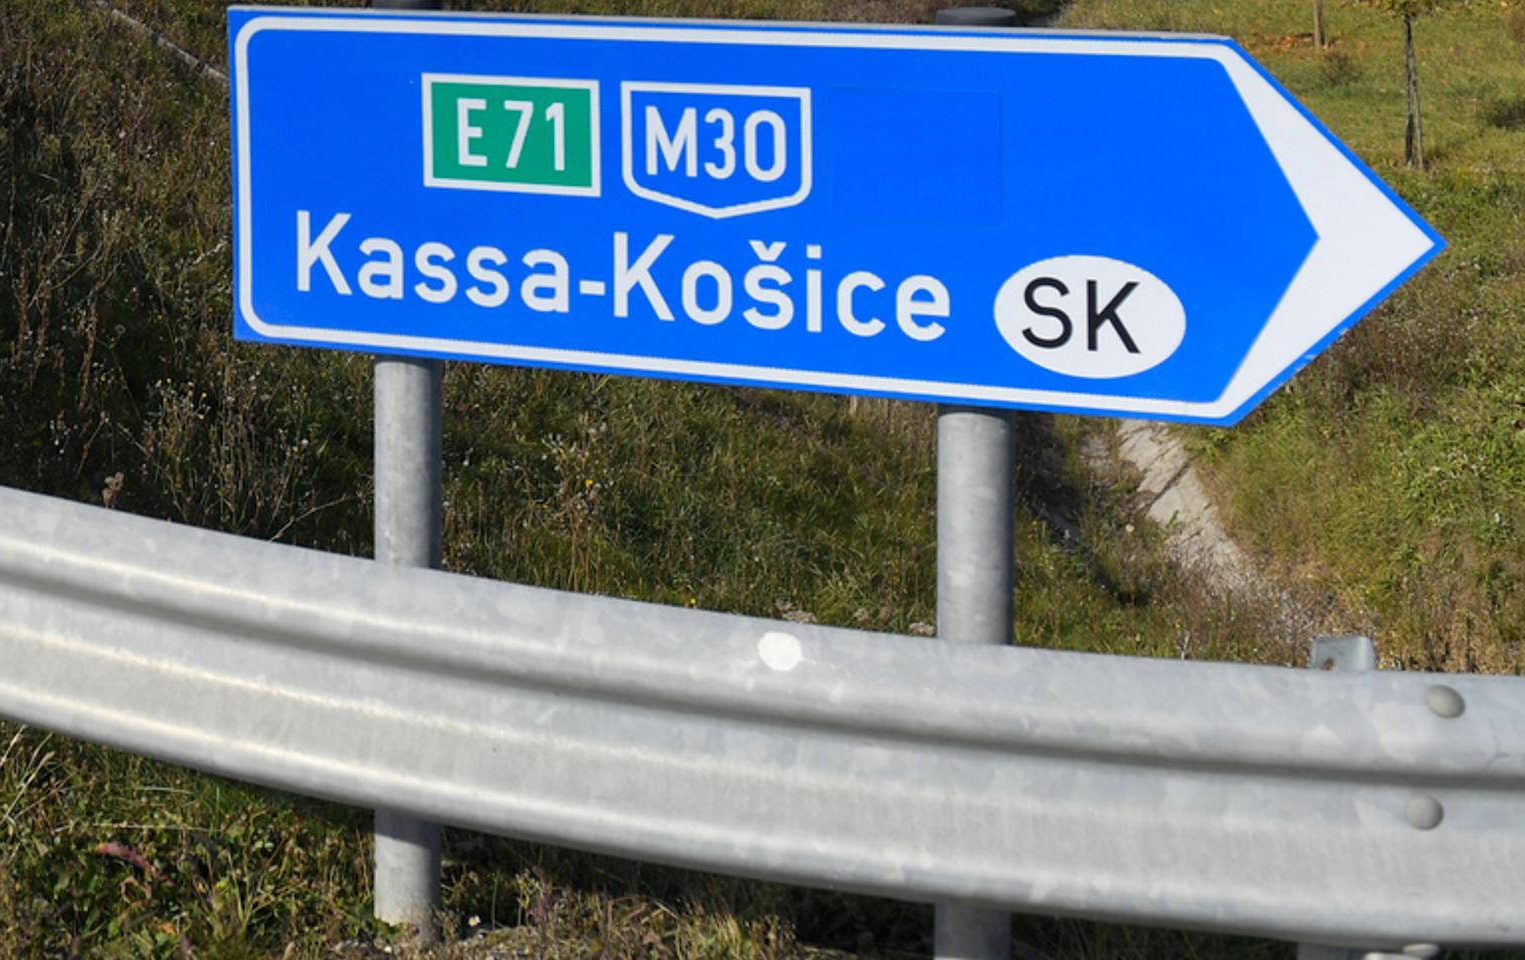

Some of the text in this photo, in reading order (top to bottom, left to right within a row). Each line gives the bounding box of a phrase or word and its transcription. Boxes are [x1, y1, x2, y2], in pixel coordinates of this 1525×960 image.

[457, 98, 787, 182] E71 M30
[297, 210, 1140, 354] Kassa-Košice SK
